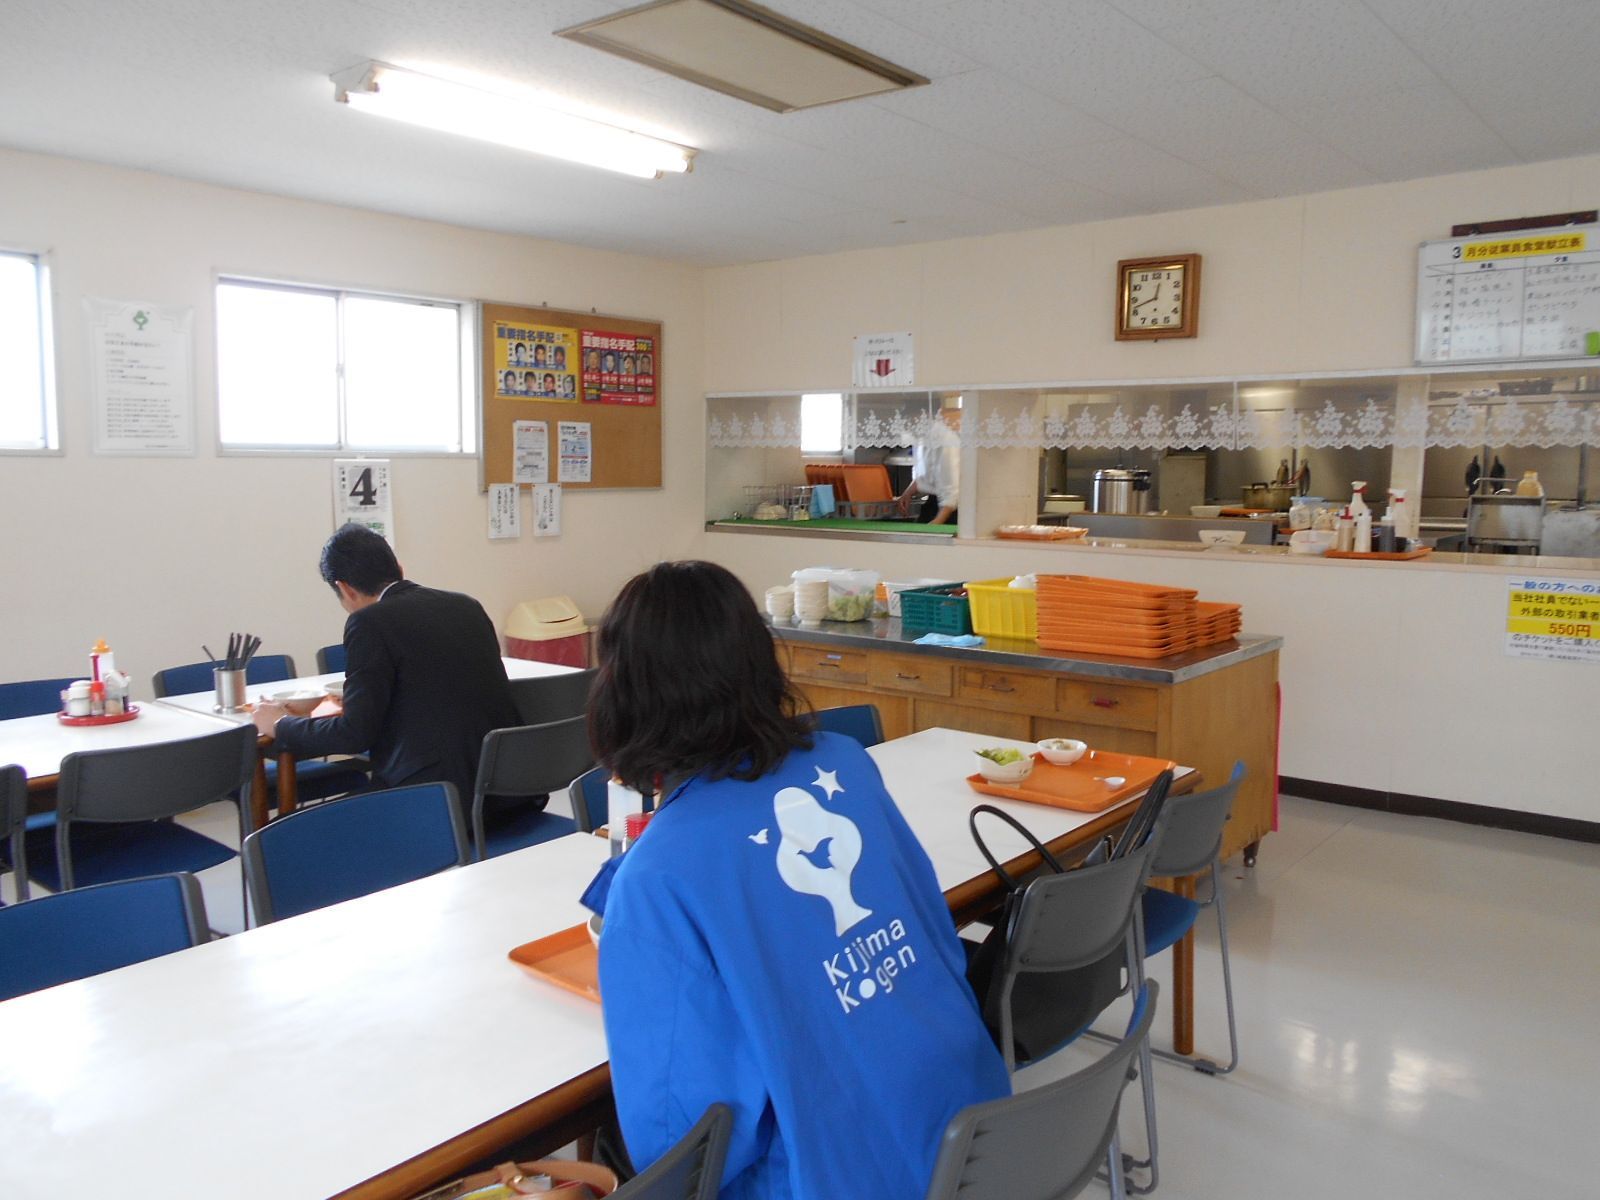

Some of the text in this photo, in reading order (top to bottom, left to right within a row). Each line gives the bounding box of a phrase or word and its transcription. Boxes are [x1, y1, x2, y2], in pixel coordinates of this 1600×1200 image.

[1453, 237, 1581, 259] 3 月分従業員食堂献立表
[1141, 274, 1149, 282] 11
[1152, 272, 1162, 280] 12
[1166, 272, 1171, 280] 1
[1174, 294, 1180, 302] 3
[1163, 316, 1170, 324] 5
[496, 326, 555, 344] 重要指名手配
[582, 335, 635, 351] 重要指名手配
[349, 467, 378, 506] 4
[1521, 607, 1600, 620] 外部の取引業者
[1549, 623, 1591, 637] 550円
[822, 918, 906, 986] Kijima
[835, 944, 917, 1015] Kogen
